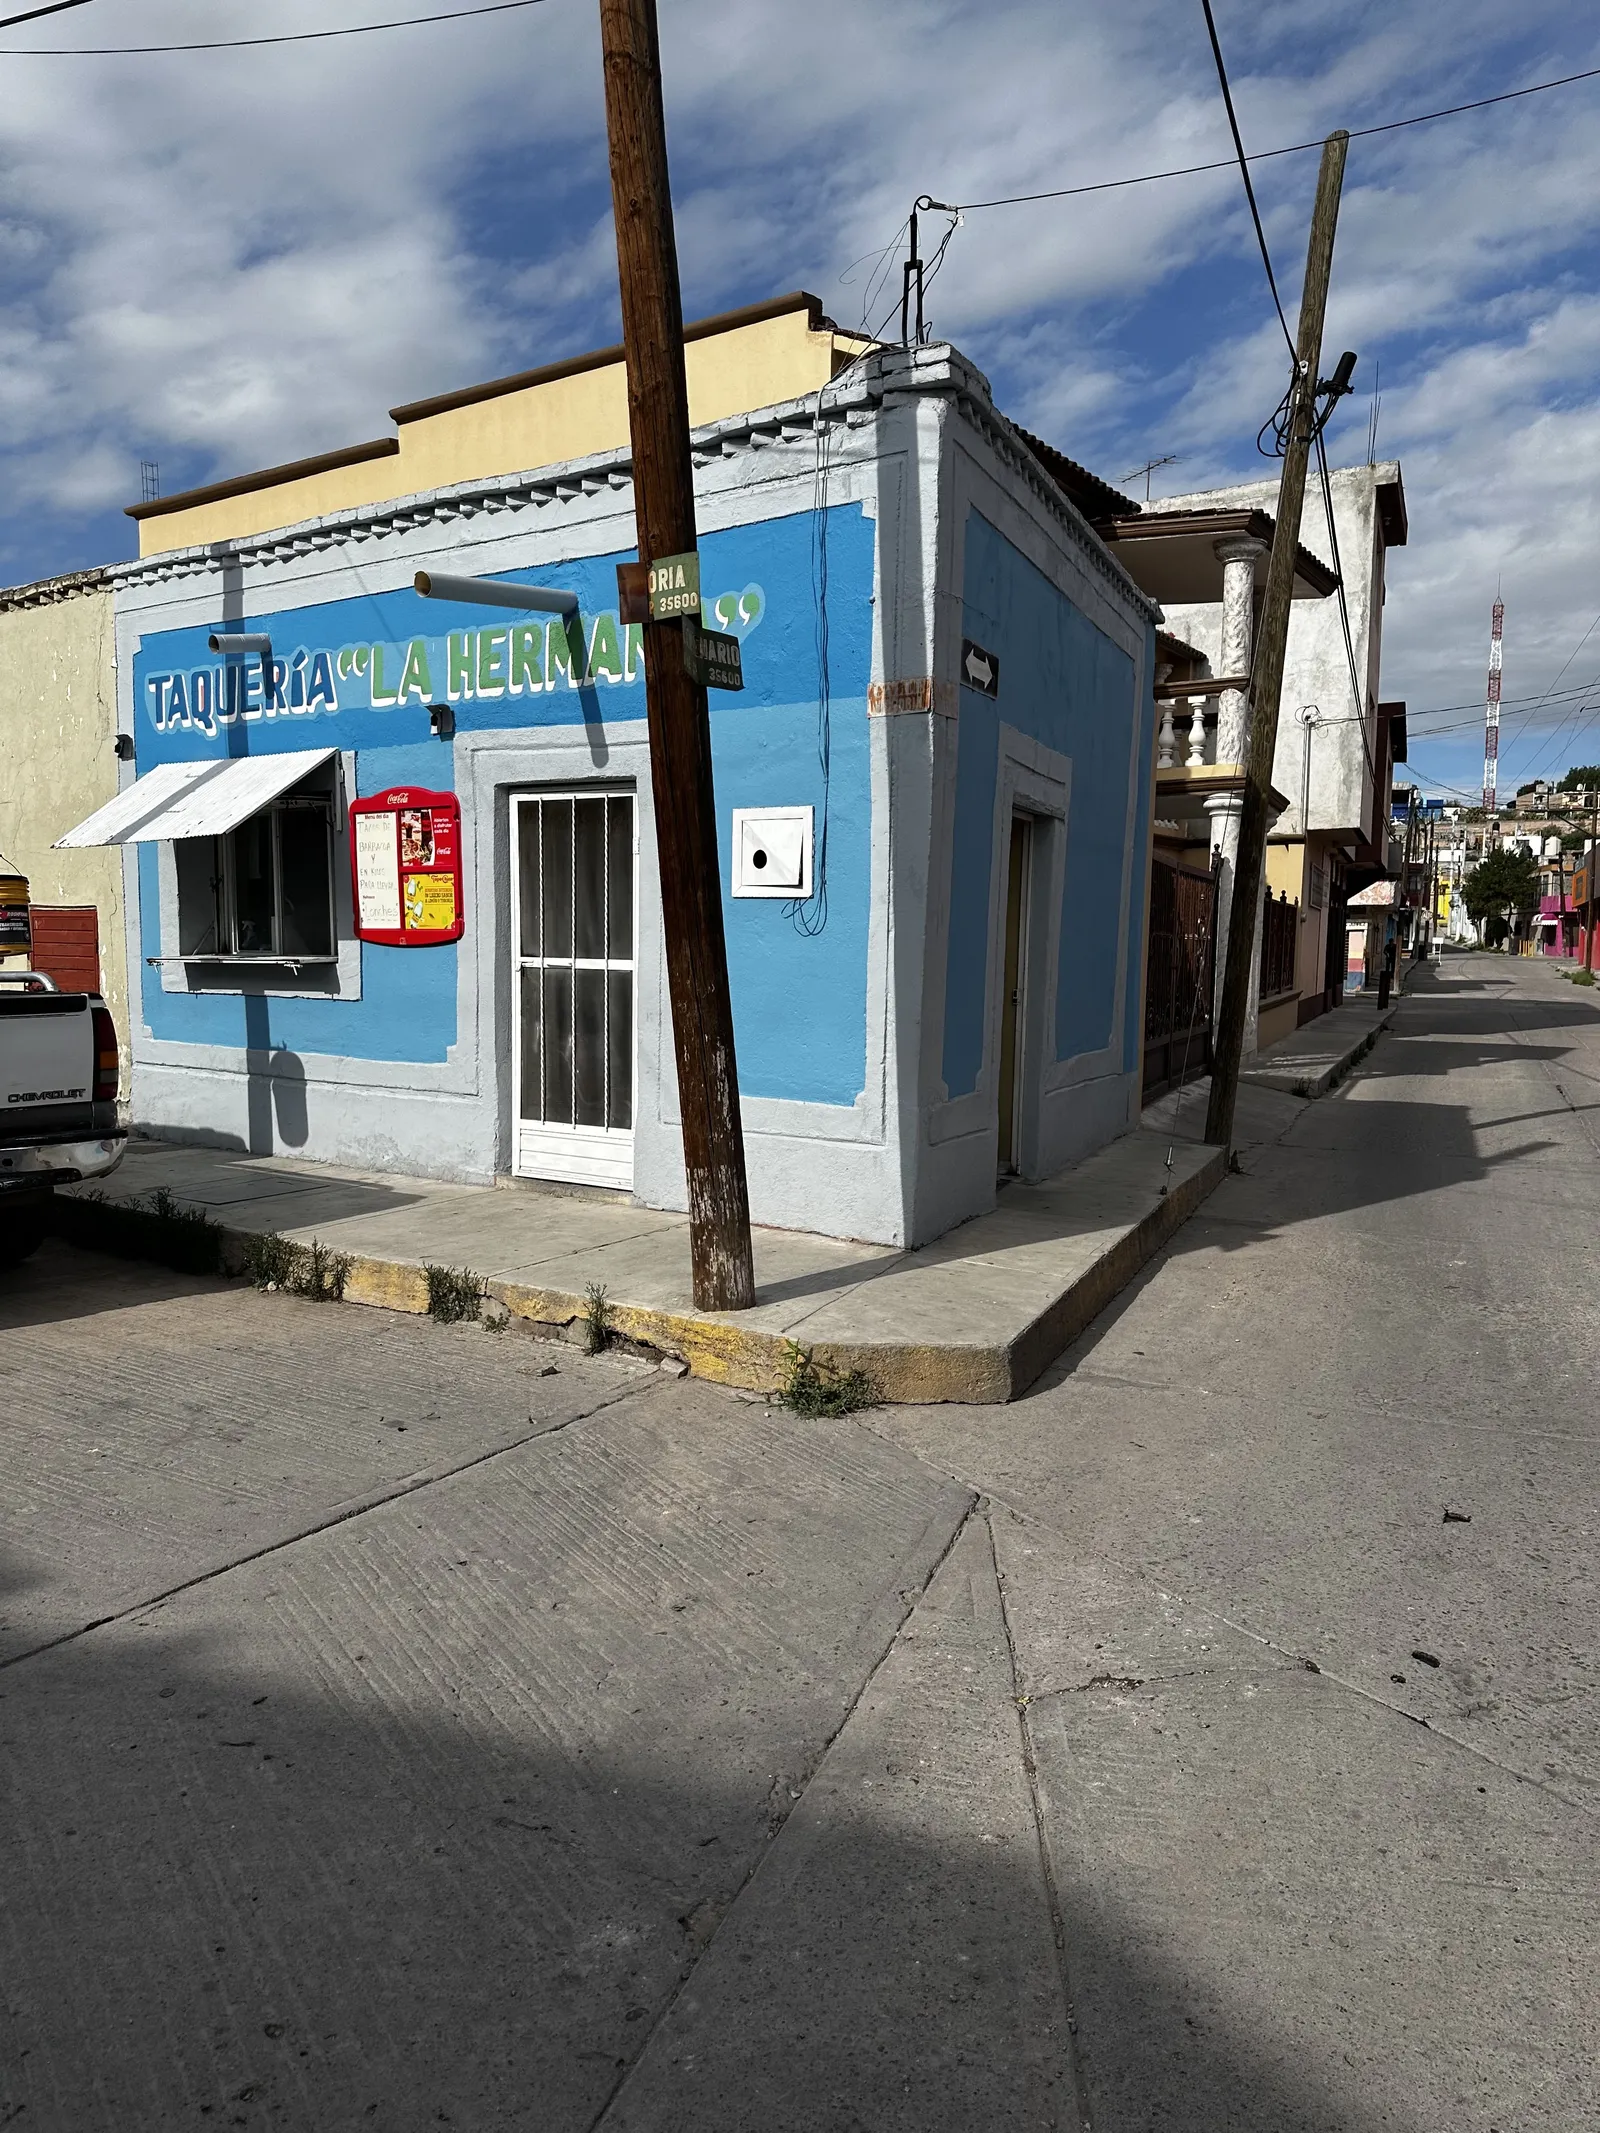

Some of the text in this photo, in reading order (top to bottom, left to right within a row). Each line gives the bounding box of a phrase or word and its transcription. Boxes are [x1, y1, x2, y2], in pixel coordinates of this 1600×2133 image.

[659, 592, 698, 612] 35600
[707, 668, 741, 686] 35600
[148, 650, 338, 736] TAQUERÍA
[387, 792, 409, 805] Coca-Cola
[8, 1088, 86, 1103] CHEVROLET
